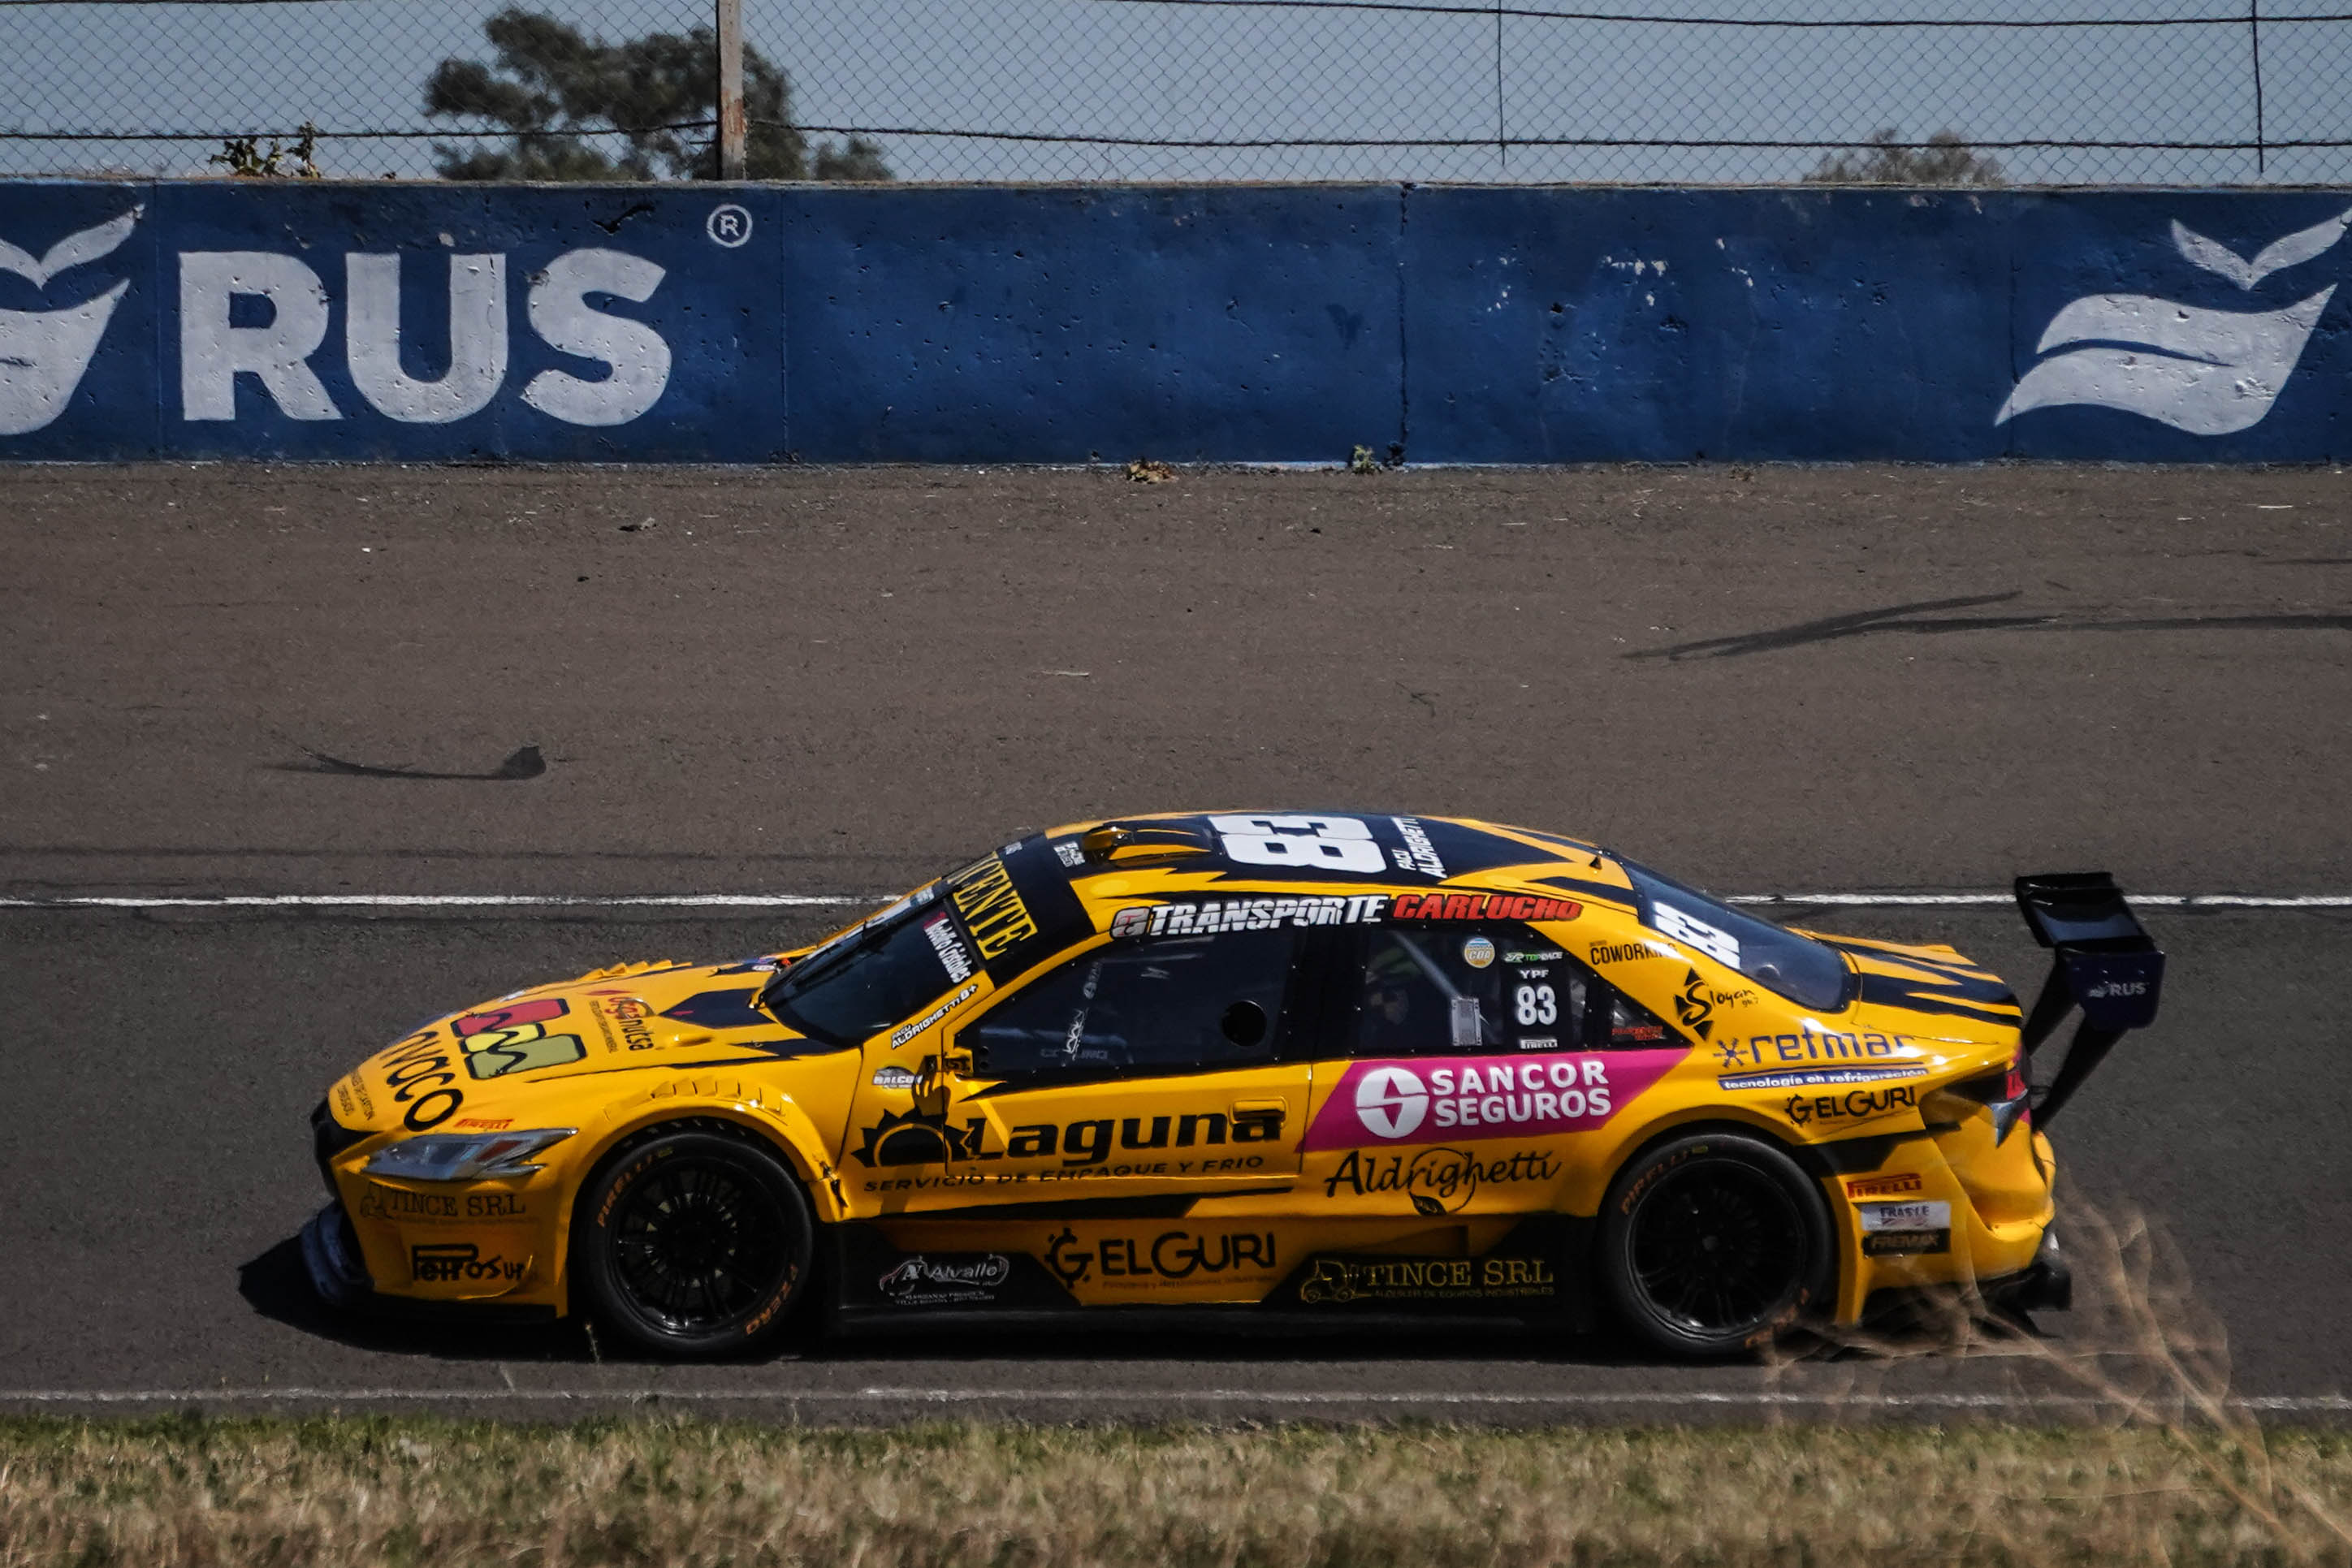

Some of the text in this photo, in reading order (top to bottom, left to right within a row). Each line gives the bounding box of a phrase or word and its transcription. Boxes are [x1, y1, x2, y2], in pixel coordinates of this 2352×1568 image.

[179, 247, 672, 427] RUS
[1208, 814, 1387, 874] 83
[1391, 849, 1417, 871] FACU
[1149, 895, 1390, 935] TRANSPORTE
[1392, 893, 1585, 922] CARLUCHO
[1590, 942, 1677, 965] COWORK
[1652, 901, 1741, 971] 83
[1520, 969, 1550, 979] YPF
[2108, 982, 2147, 996] RUS
[891, 996, 961, 1049] ALDRIGHETTI
[1516, 985, 1558, 1026] 83
[1520, 1039, 1559, 1049] PIRELLI
[1432, 1060, 1610, 1096] SANCOR
[1723, 1073, 1805, 1090] tecnología
[452, 1118, 515, 1130] PIRELLI
[1434, 1087, 1612, 1128] SEGUROS
[962, 1109, 1283, 1167] Laguna
[863, 1173, 986, 1193] SERVICIO
[997, 1173, 1028, 1185] DE
[1178, 1160, 1190, 1173] Y
[1200, 1155, 1265, 1172] FRIO
[1325, 1147, 1563, 1199] Aldrighetti
[1846, 1173, 1922, 1199] PIRELLI
[390, 1190, 527, 1216] TINCE SRL
[1367, 1259, 1554, 1287] TINCE SRL
